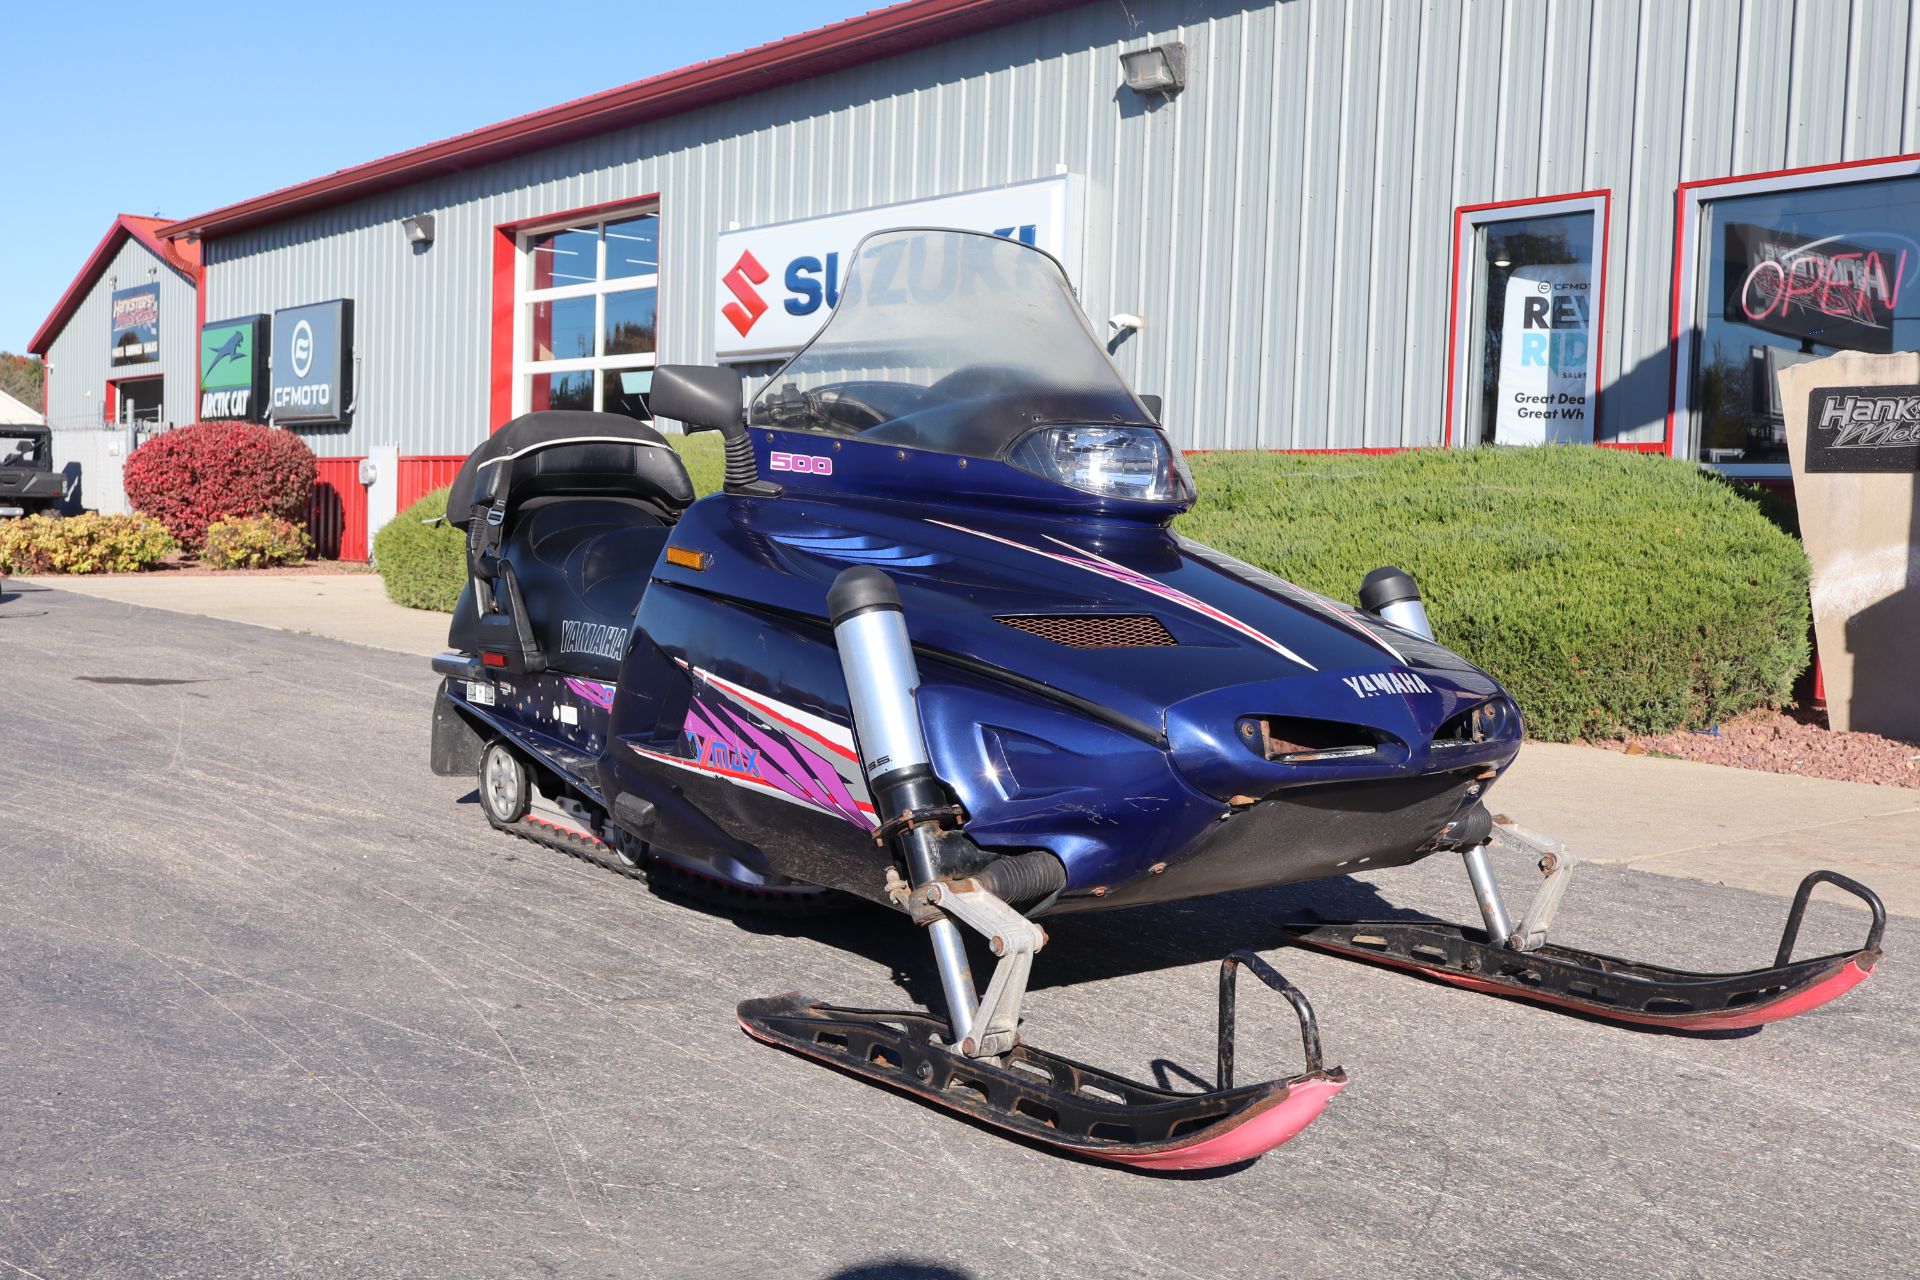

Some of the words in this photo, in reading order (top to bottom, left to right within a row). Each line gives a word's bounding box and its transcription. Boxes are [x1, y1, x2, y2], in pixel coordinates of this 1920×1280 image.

[784, 224, 1036, 316] SUZUKI
[1742, 249, 1907, 320] OPEN
[201, 391, 231, 418] ARCTIC
[230, 390, 249, 416] CAT
[274, 384, 330, 408] CFMOTO
[1514, 392, 1555, 404] Great
[1517, 407, 1558, 419] Great
[770, 451, 832, 475] 500
[560, 620, 627, 661] YAMAHA
[1342, 672, 1433, 698] YAMAHA
